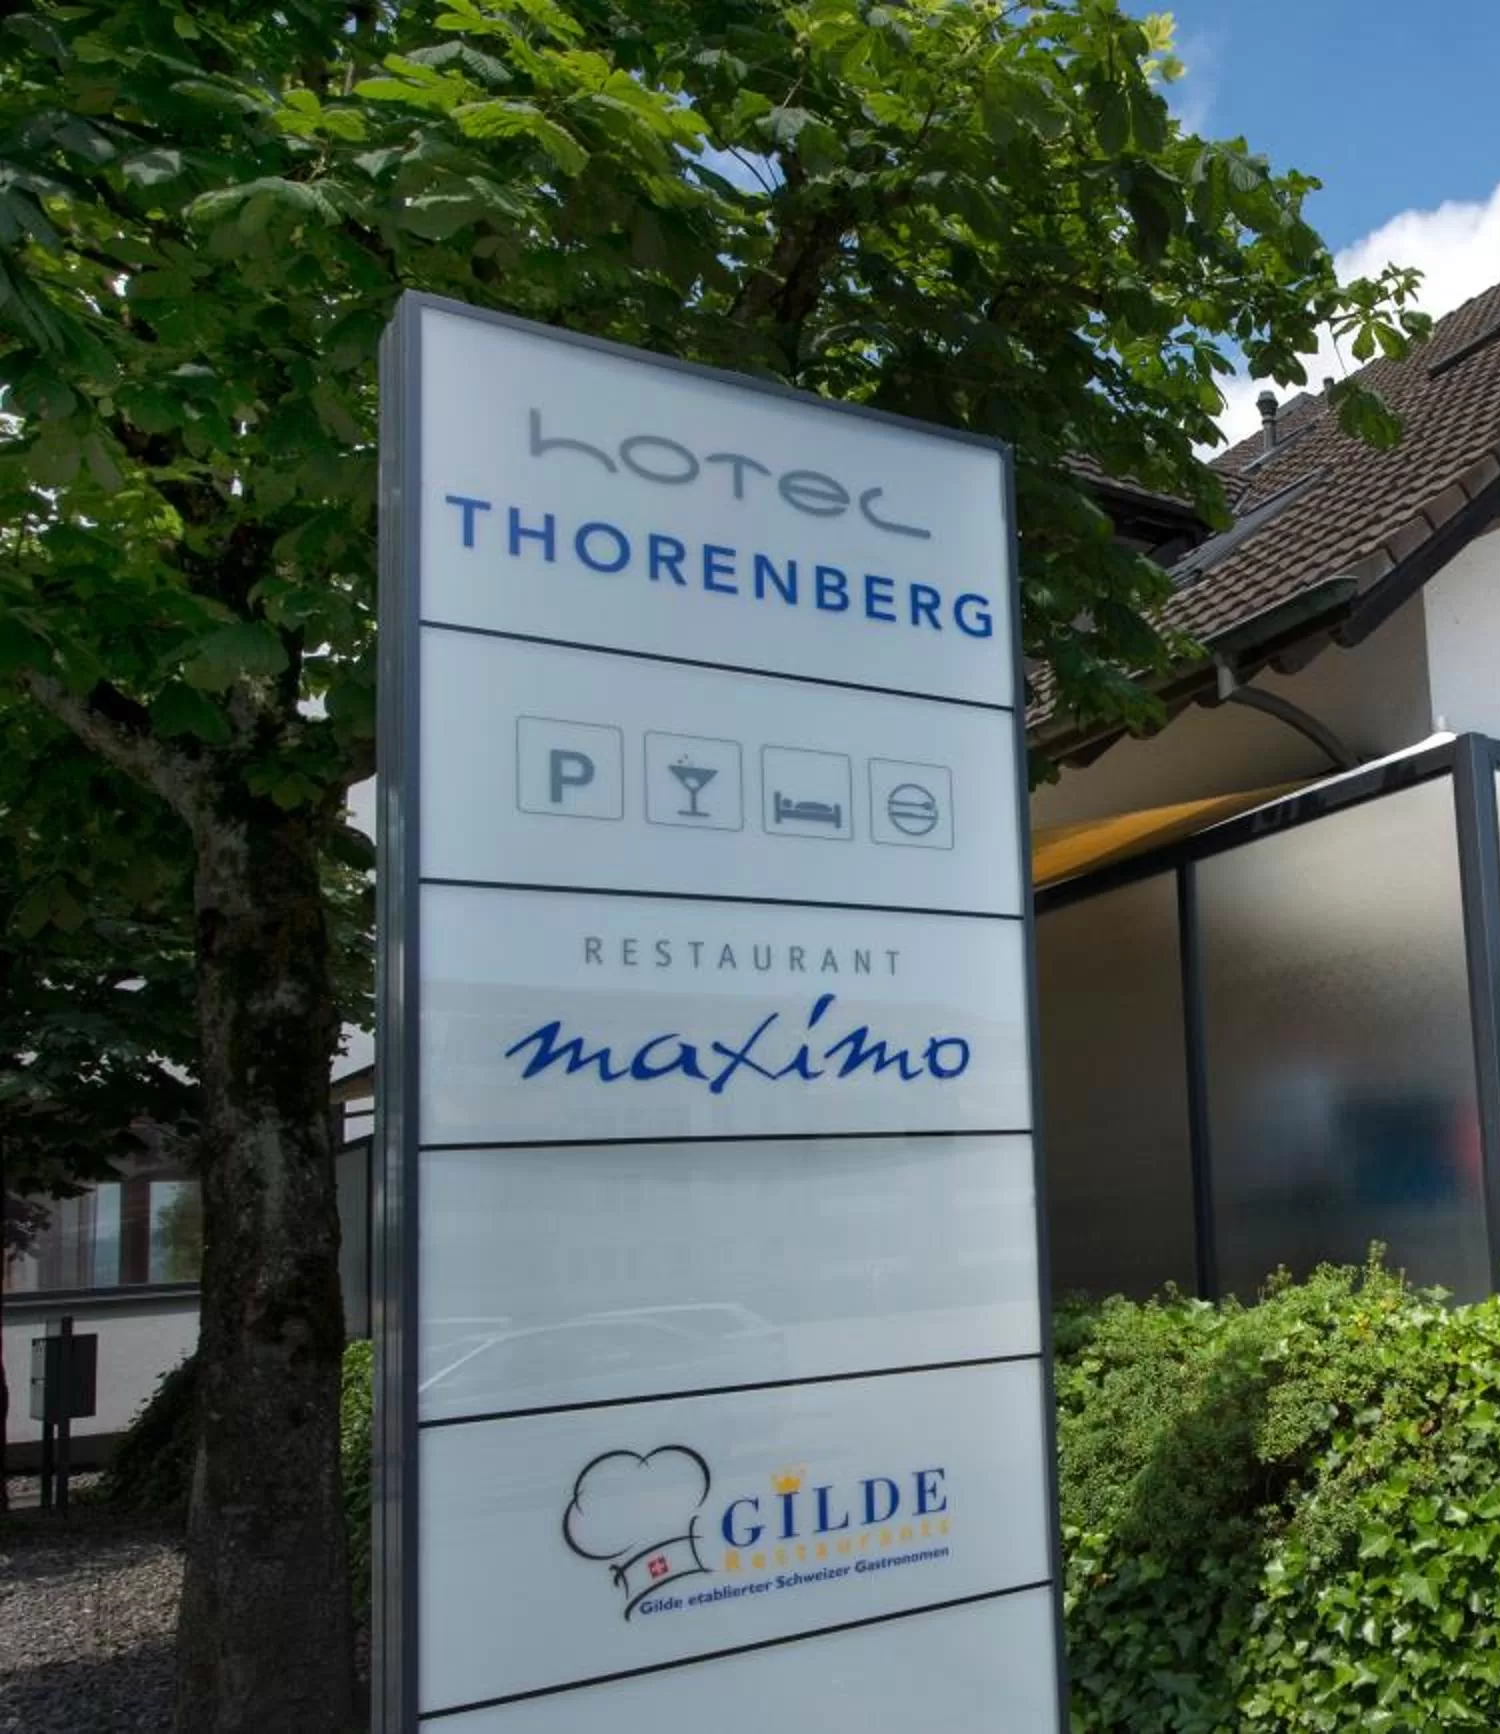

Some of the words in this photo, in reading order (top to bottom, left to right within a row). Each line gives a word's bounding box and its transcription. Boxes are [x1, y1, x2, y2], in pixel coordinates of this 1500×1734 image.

[445, 494, 994, 638] THORENBERG
[549, 749, 595, 803] P
[584, 937, 901, 976] RESTAURANT
[721, 1467, 948, 1548] GILDE
[639, 1598, 683, 1615] Gilde
[687, 1579, 772, 1606] etablierter
[775, 1564, 850, 1590] Schweizer
[854, 1546, 950, 1573] Gastronomen
